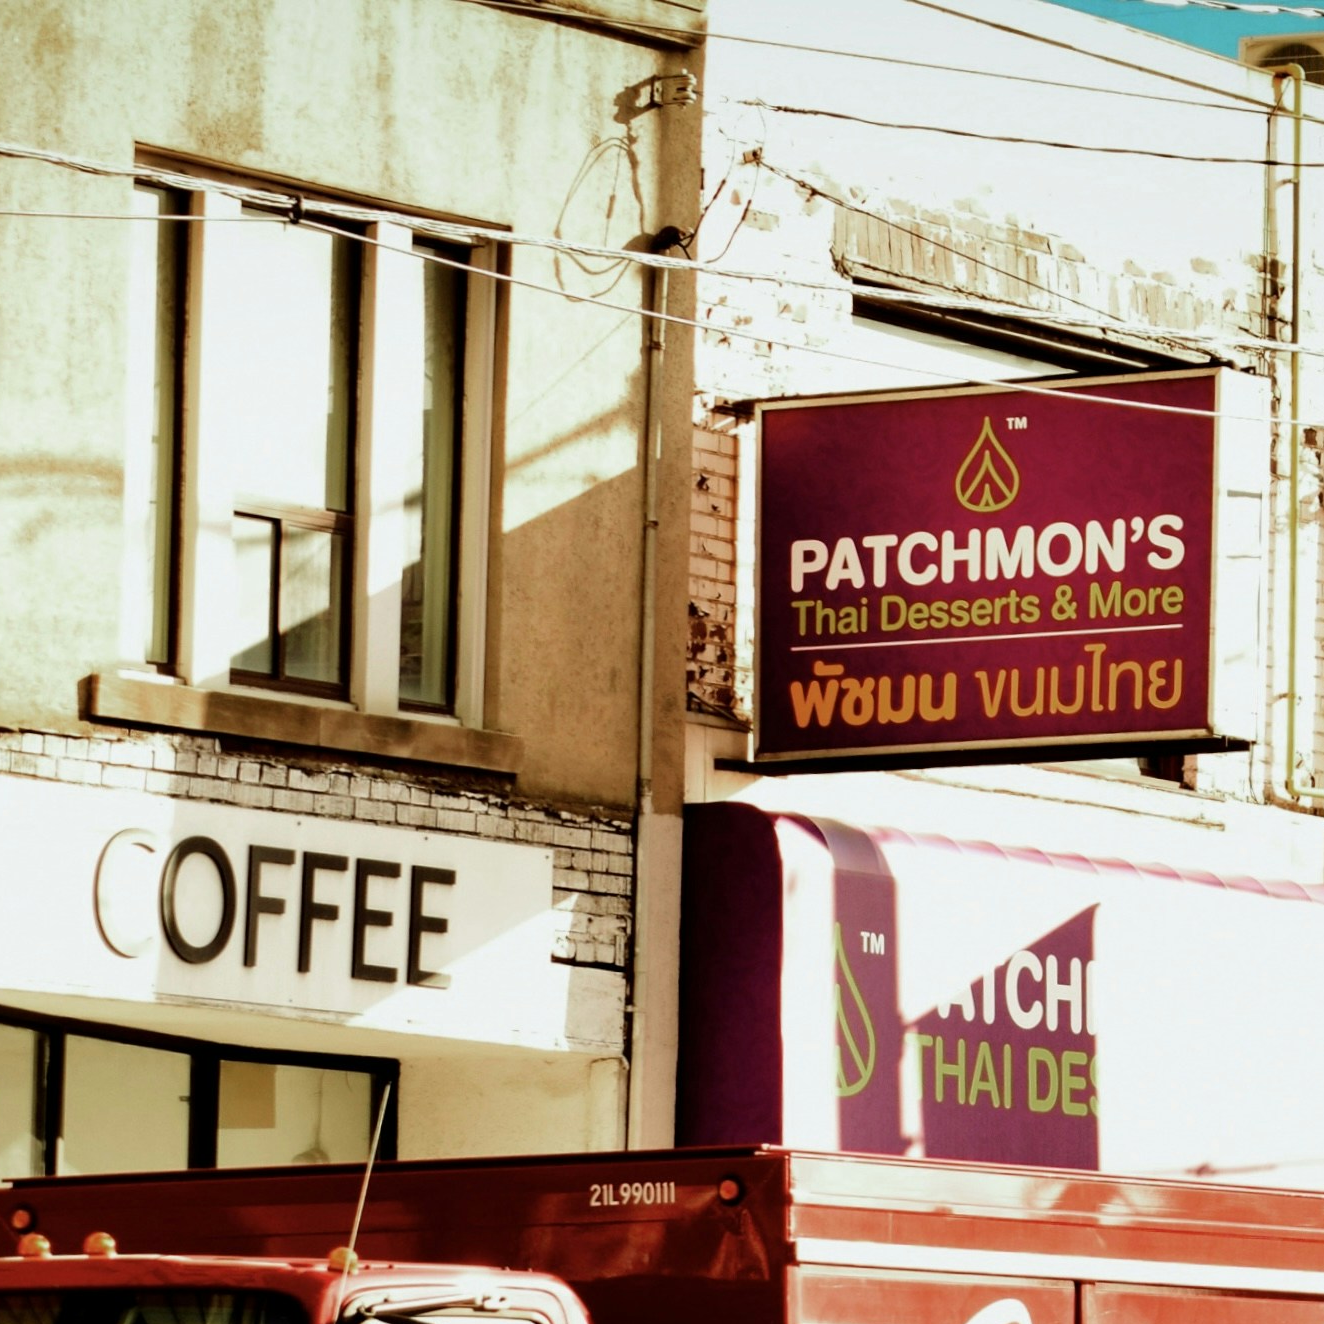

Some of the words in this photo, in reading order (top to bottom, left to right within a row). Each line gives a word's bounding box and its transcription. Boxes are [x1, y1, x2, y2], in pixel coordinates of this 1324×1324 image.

[1006, 416, 1028, 430] TM
[790, 513, 1186, 593] PATCHMON'S
[791, 598, 868, 637] Thai
[880, 589, 1041, 632] Desserts
[1050, 584, 1077, 621] &
[1088, 580, 1184, 620] More
[93, 827, 458, 990] COFFEE
[860, 931, 886, 956] TM
